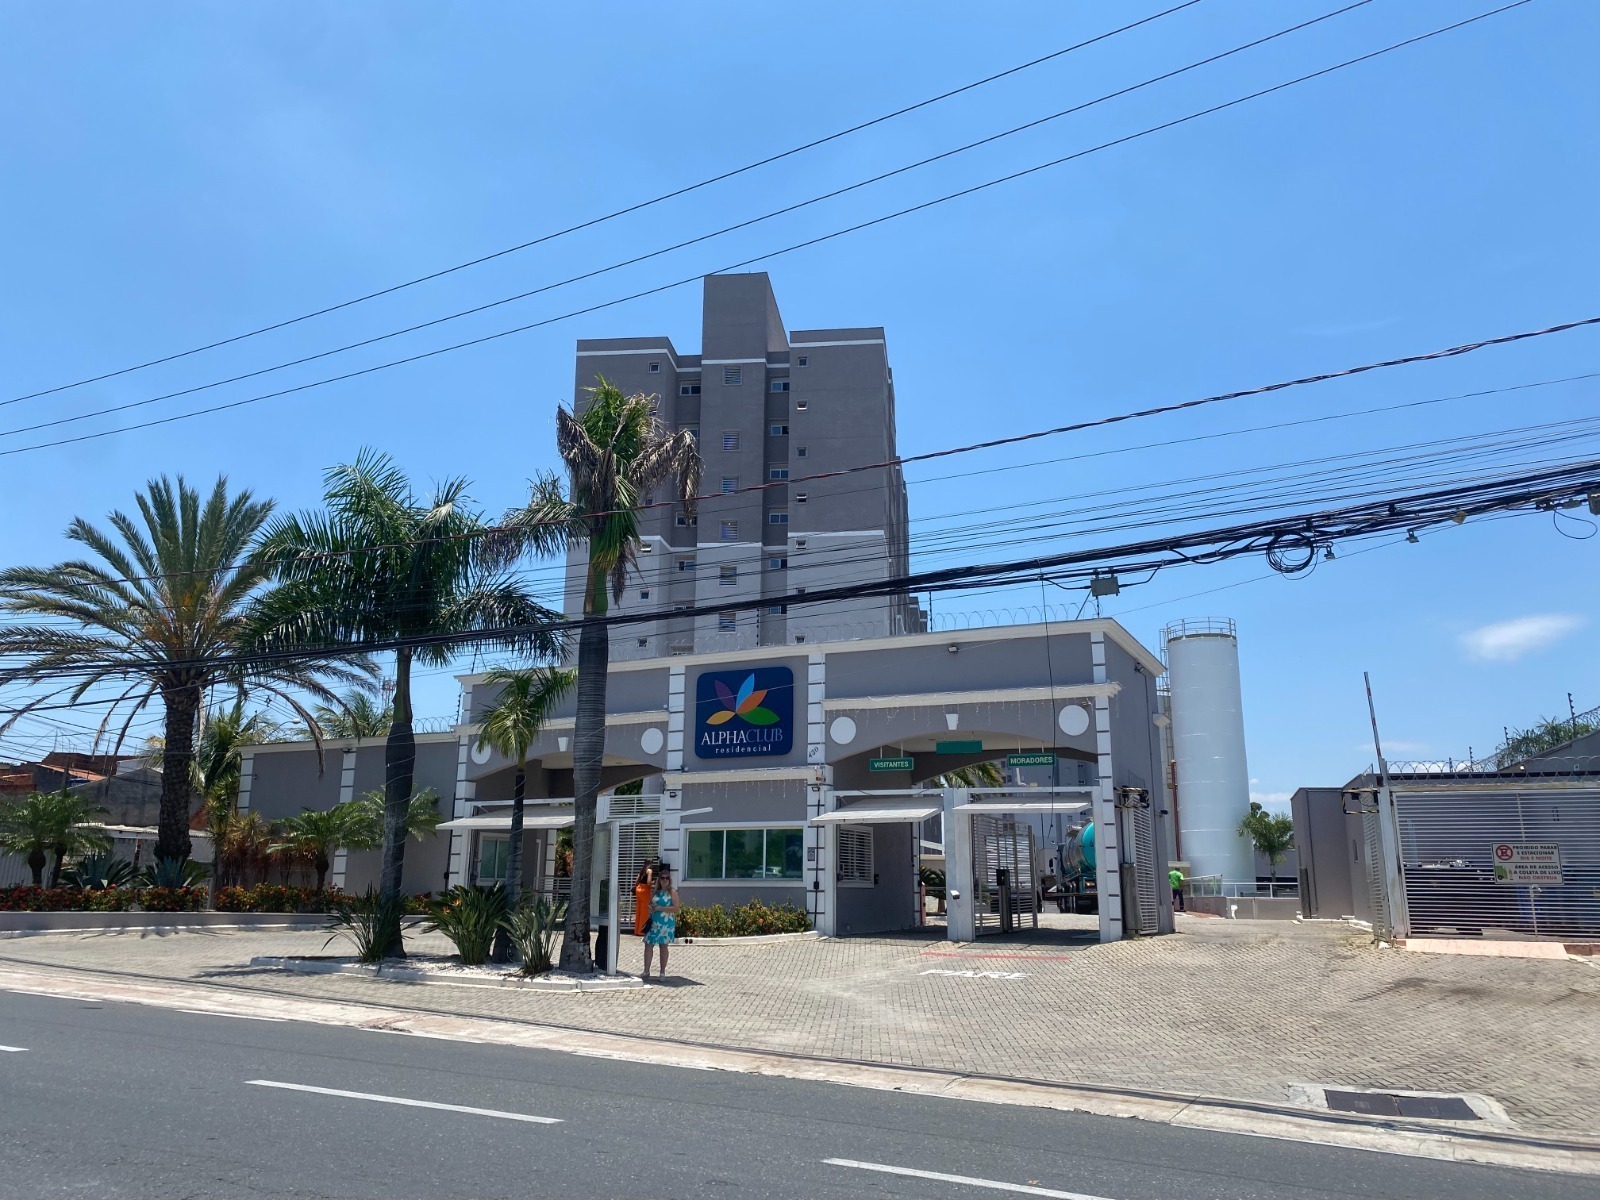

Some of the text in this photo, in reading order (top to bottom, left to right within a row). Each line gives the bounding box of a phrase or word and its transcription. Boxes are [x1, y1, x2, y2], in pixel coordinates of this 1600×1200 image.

[701, 728, 783, 745] ALPHACLUB
[716, 744, 771, 754] residencial
[1010, 756, 1052, 764] MORADORES
[918, 969, 1034, 980] PARE
